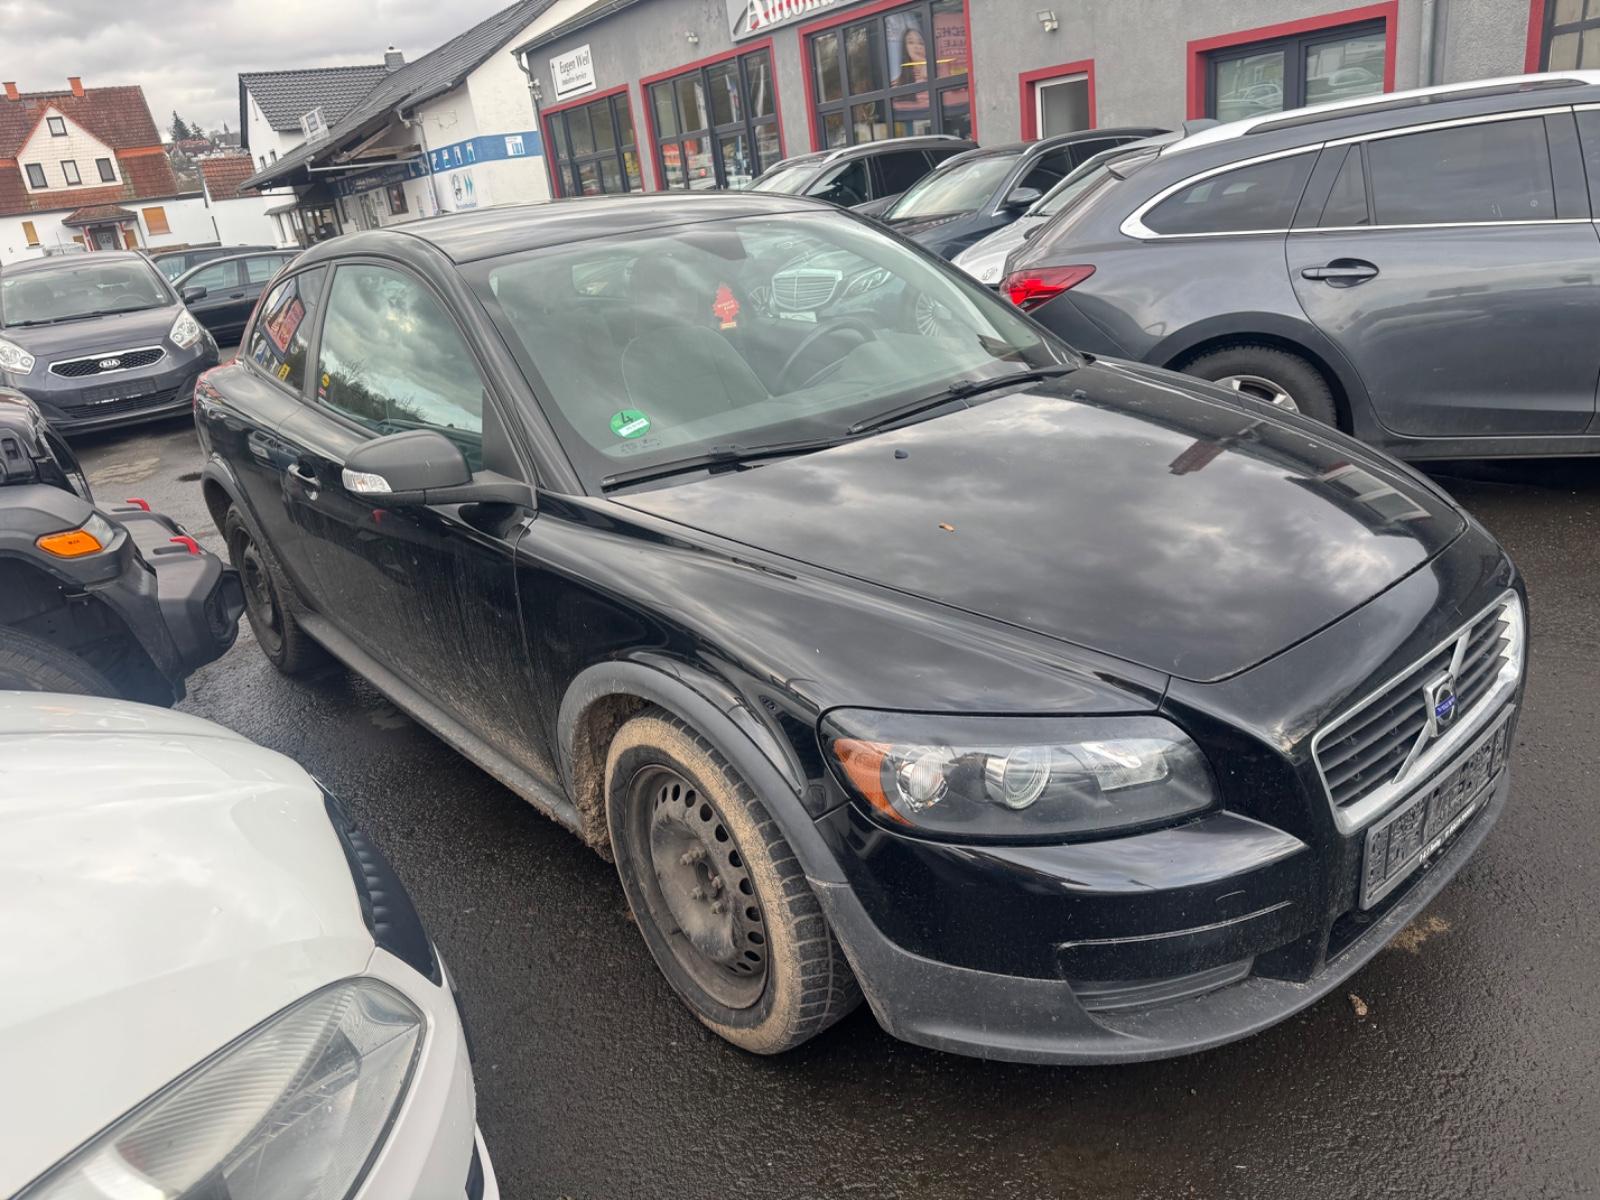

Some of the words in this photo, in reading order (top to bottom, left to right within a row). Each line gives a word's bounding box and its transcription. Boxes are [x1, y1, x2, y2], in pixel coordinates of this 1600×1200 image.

[560, 60, 575, 73] Eugen
[576, 50, 589, 68] Weil
[102, 360, 117, 368] KIA
[621, 412, 633, 424] 4
